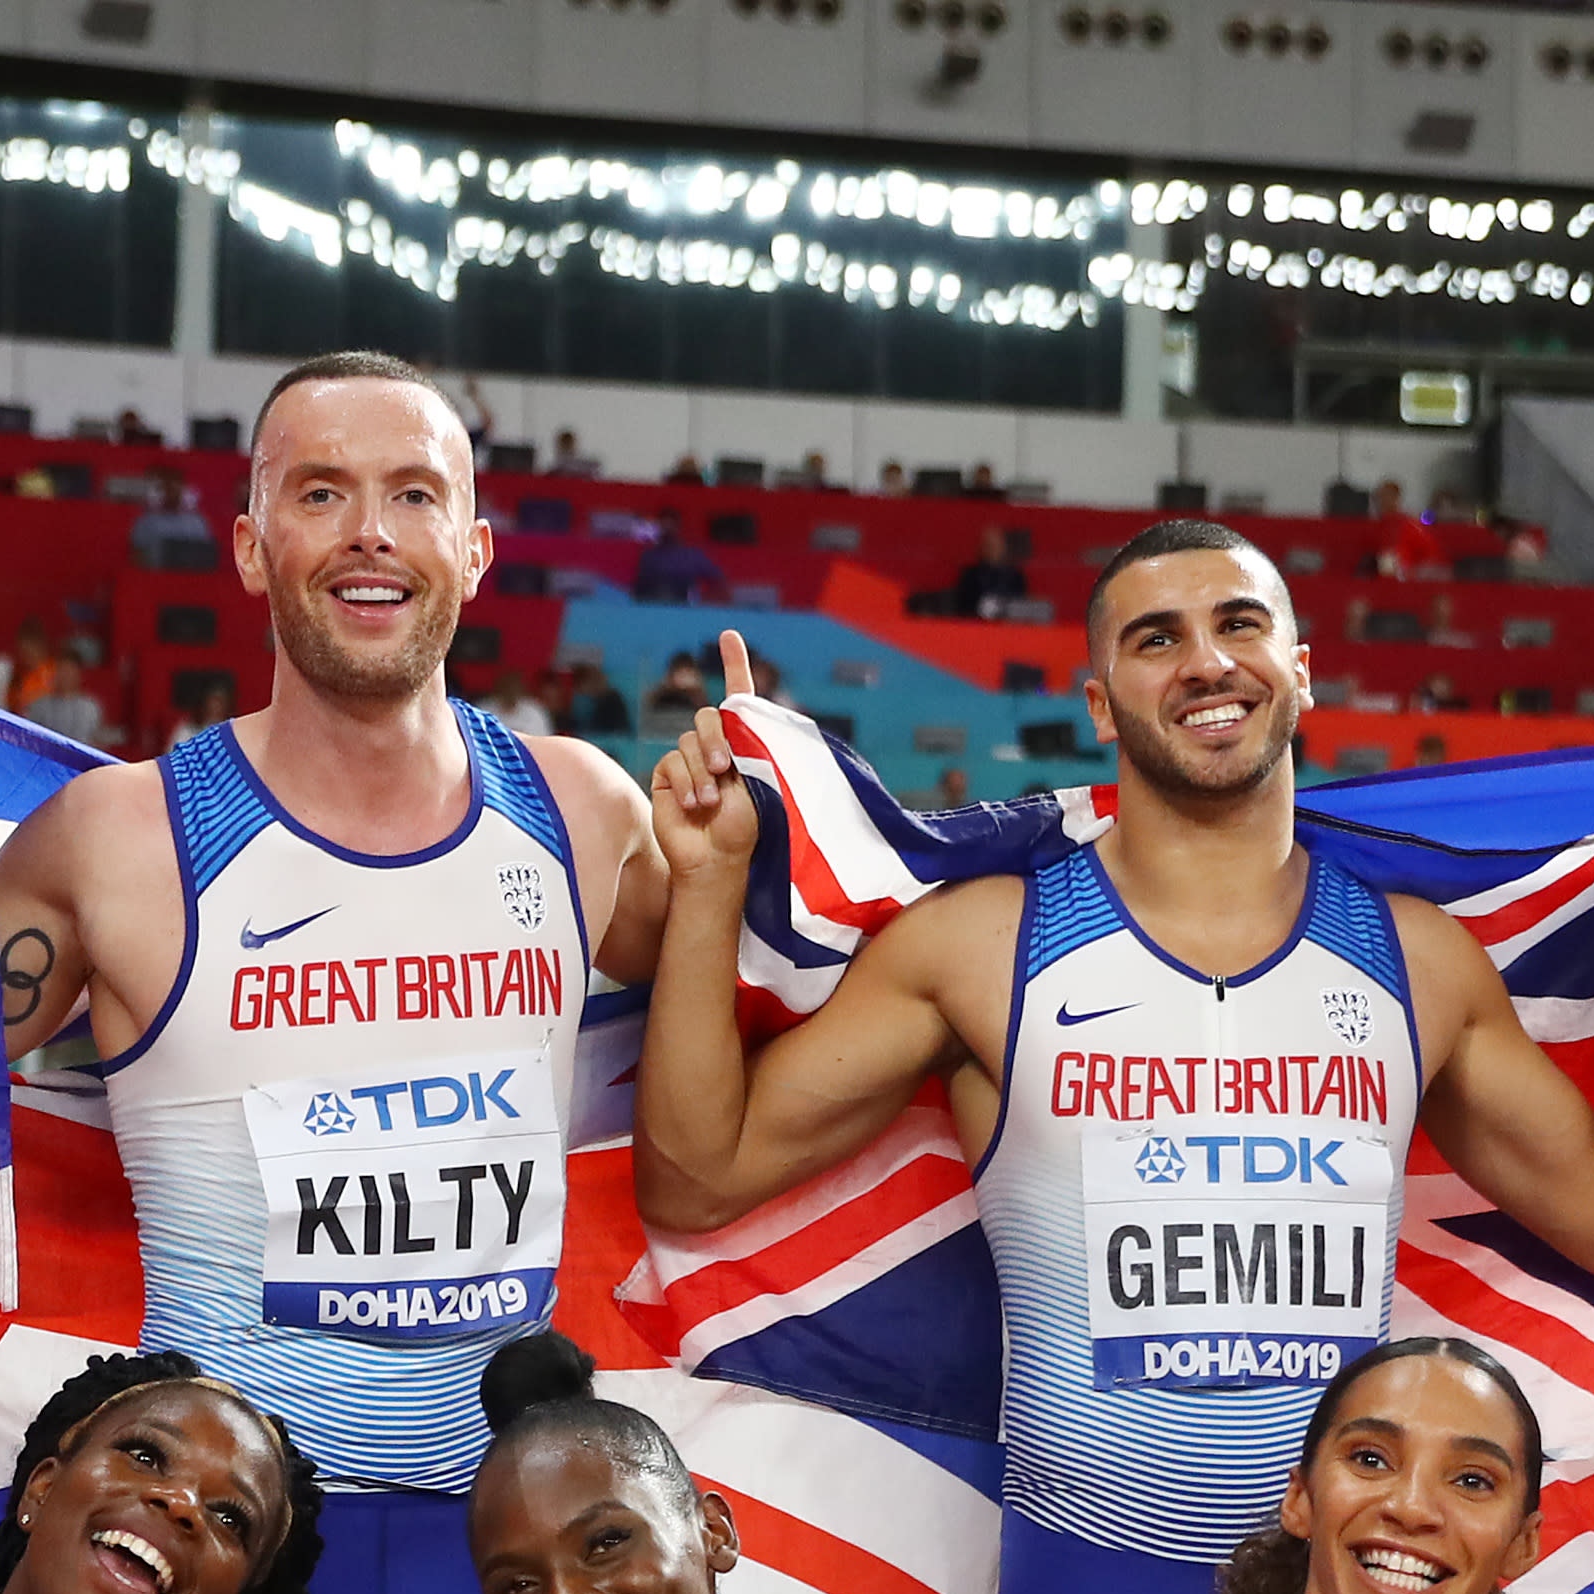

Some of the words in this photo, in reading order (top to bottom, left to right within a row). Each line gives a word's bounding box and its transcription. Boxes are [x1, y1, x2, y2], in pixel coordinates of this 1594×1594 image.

[230, 958, 387, 1031] GREAT
[396, 948, 562, 1021] BRITAIN
[351, 1068, 521, 1131] TDK
[1051, 1051, 1207, 1121] GREAT
[1215, 1055, 1388, 1126] BRITAIN
[1186, 1136, 1350, 1187] TDK
[296, 1160, 536, 1256] KILTY
[1106, 1223, 1366, 1310] GEMILI
[318, 1277, 528, 1328] DOHA2019
[1144, 1339, 1342, 1380] DOHA2019
